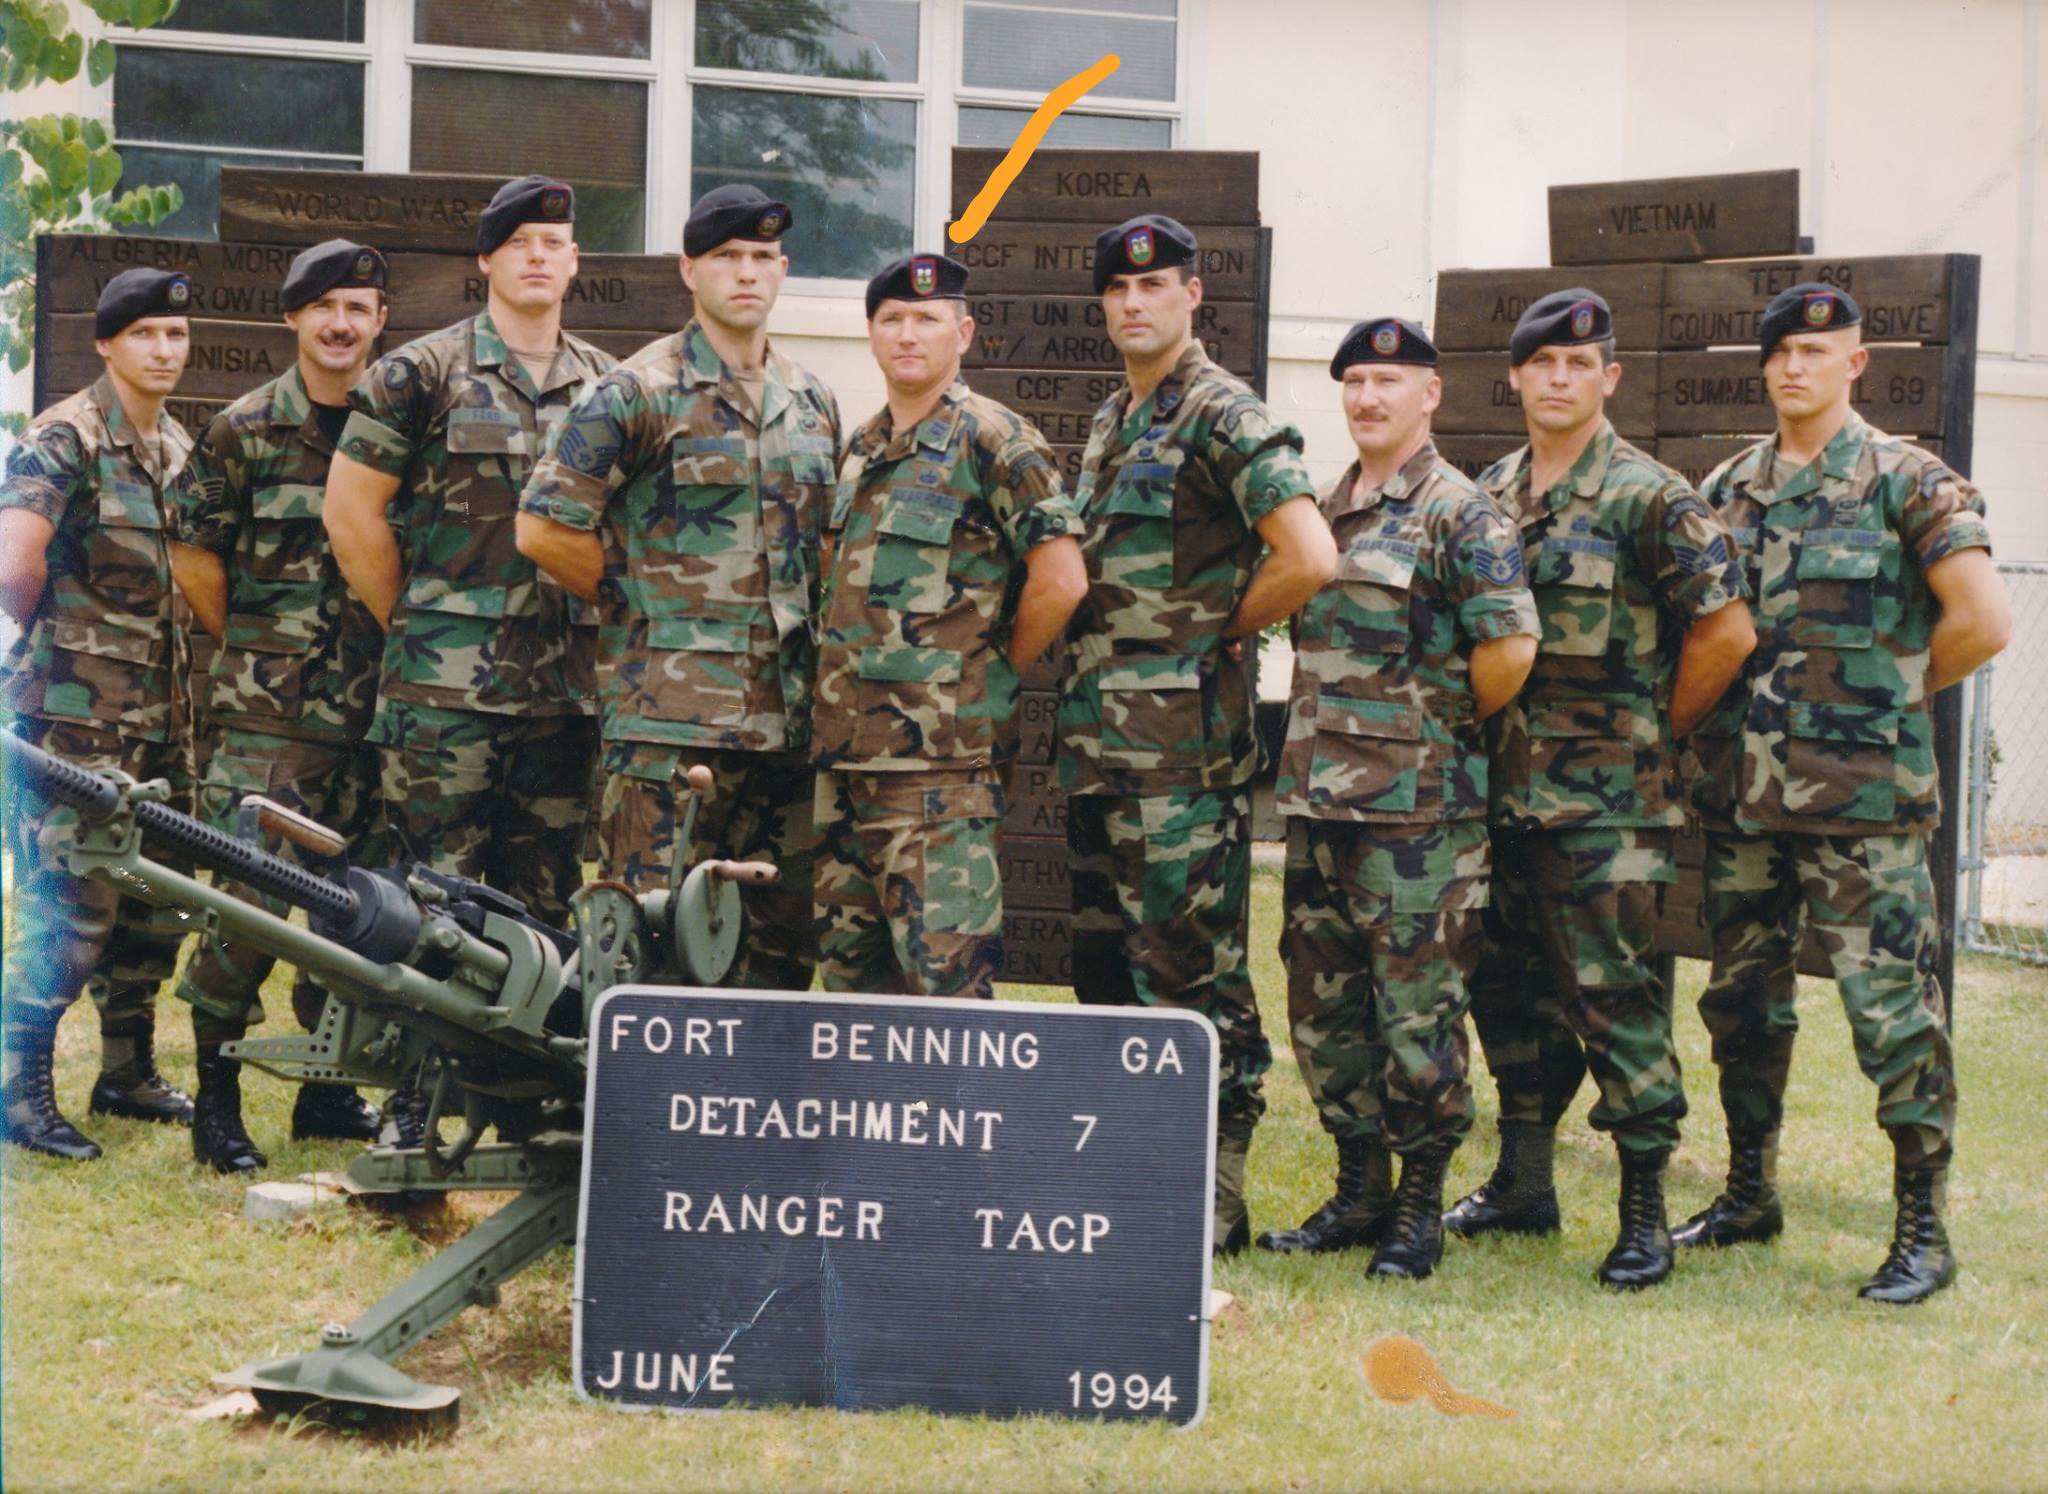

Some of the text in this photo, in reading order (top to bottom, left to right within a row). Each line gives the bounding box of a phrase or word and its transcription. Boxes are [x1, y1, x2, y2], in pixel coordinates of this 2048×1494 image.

[1056, 172, 1152, 199] KOREA
[275, 193, 469, 224] WORLD WAR
[1610, 201, 1717, 235] VIETNAM
[69, 236, 201, 264] ALGERIA
[964, 243, 1243, 274] CCF INTEION
[1749, 264, 1853, 296] TET 69
[1033, 303, 1068, 326] UN
[1669, 304, 1934, 342] COUNTESIVE
[979, 336, 1026, 361] W/
[1016, 376, 1069, 400] CCF
[1888, 375, 1925, 404] 69
[611, 1014, 1183, 1075] FORT BENNING GA
[669, 1094, 1097, 1152] DETACHMENT 7
[664, 1191, 1110, 1254] RANGER TACP
[596, 1350, 1178, 1412] JUNE 1994
